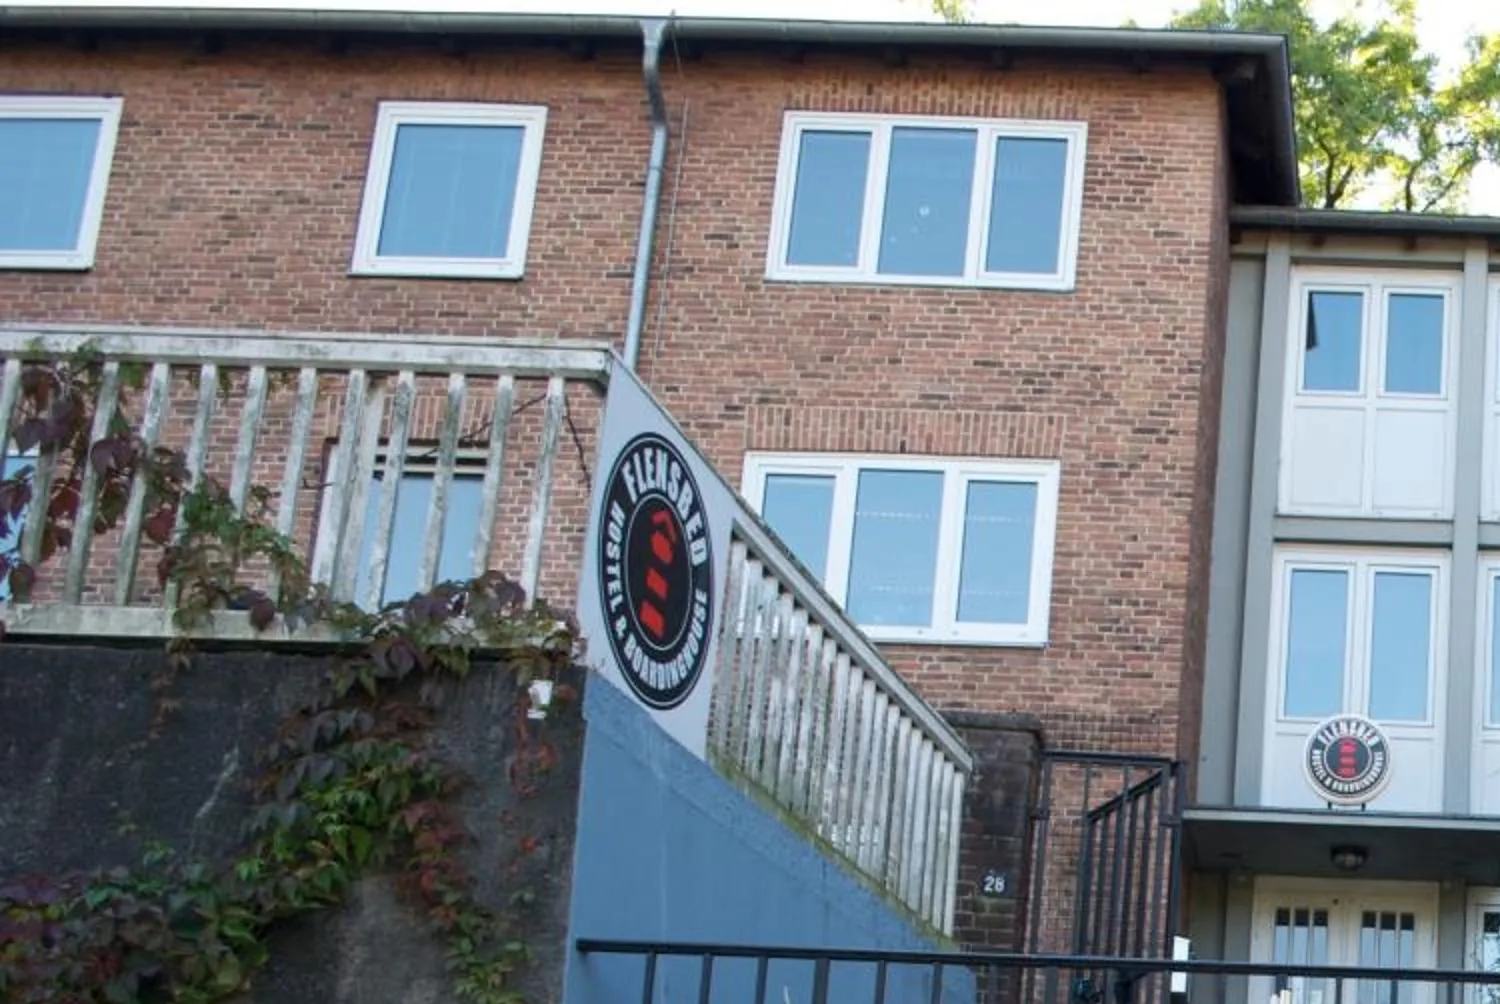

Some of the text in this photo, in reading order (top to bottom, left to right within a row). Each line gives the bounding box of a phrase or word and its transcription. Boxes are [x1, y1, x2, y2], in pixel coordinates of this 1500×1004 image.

[605, 500, 626, 614] HOSTEL
[622, 448, 707, 566] FLENSBED
[615, 621, 627, 638] &
